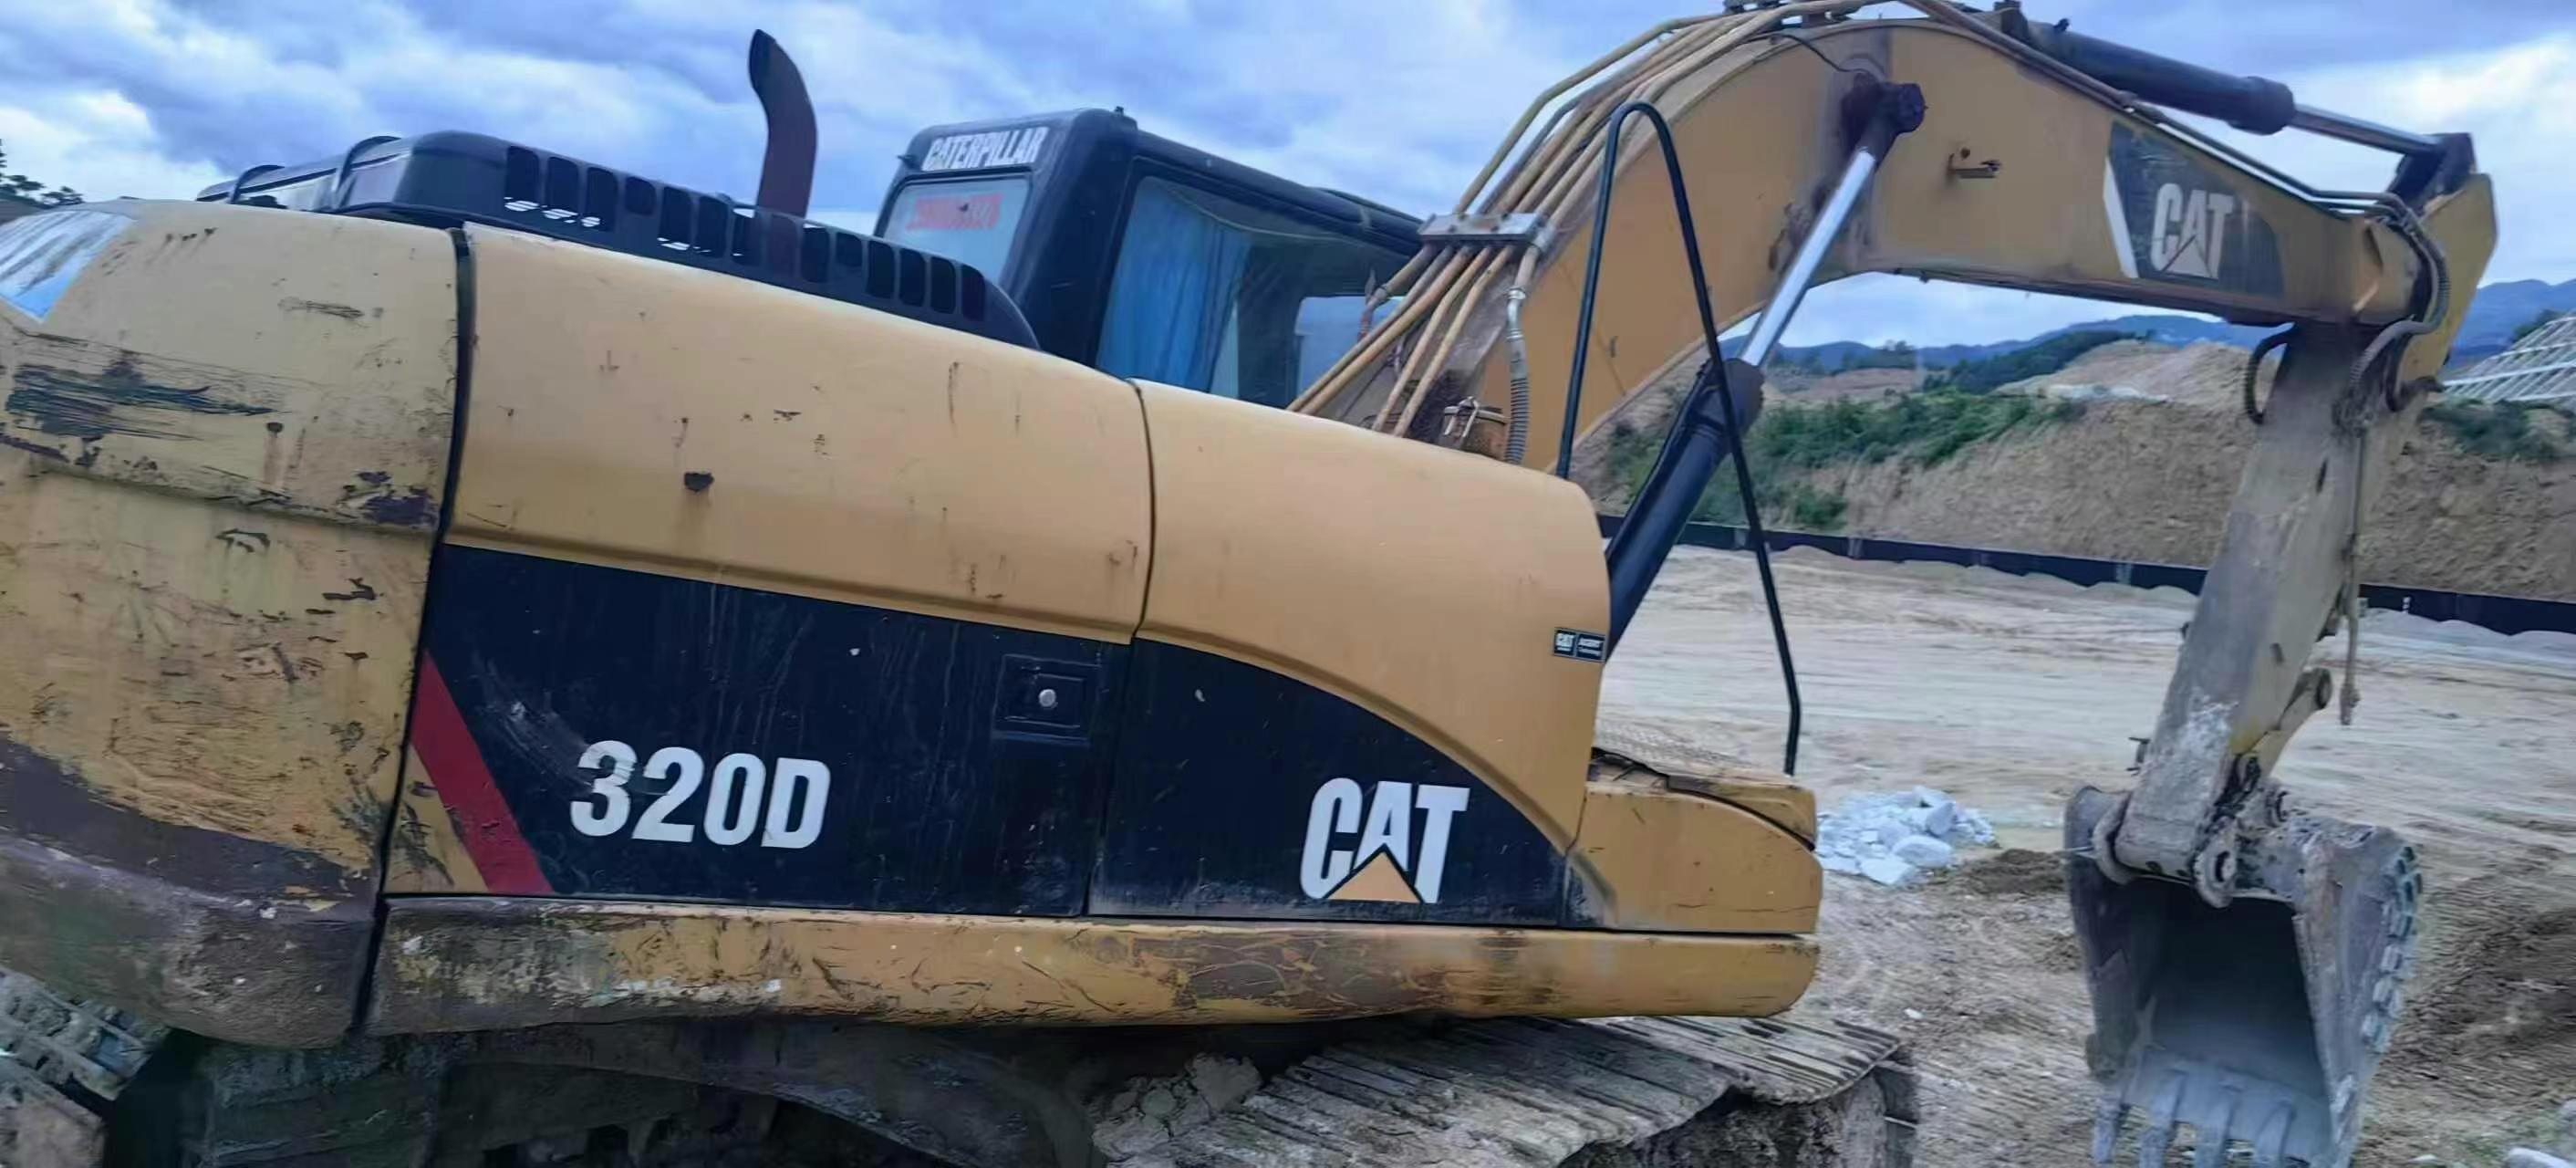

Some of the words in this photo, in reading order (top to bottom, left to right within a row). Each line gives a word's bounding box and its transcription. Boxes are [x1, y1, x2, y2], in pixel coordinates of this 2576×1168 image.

[921, 126, 1049, 172] CATERPILLAR
[2150, 182, 2234, 277] CAT
[570, 740, 831, 849] 320D
[1300, 777, 1470, 903] CAT
